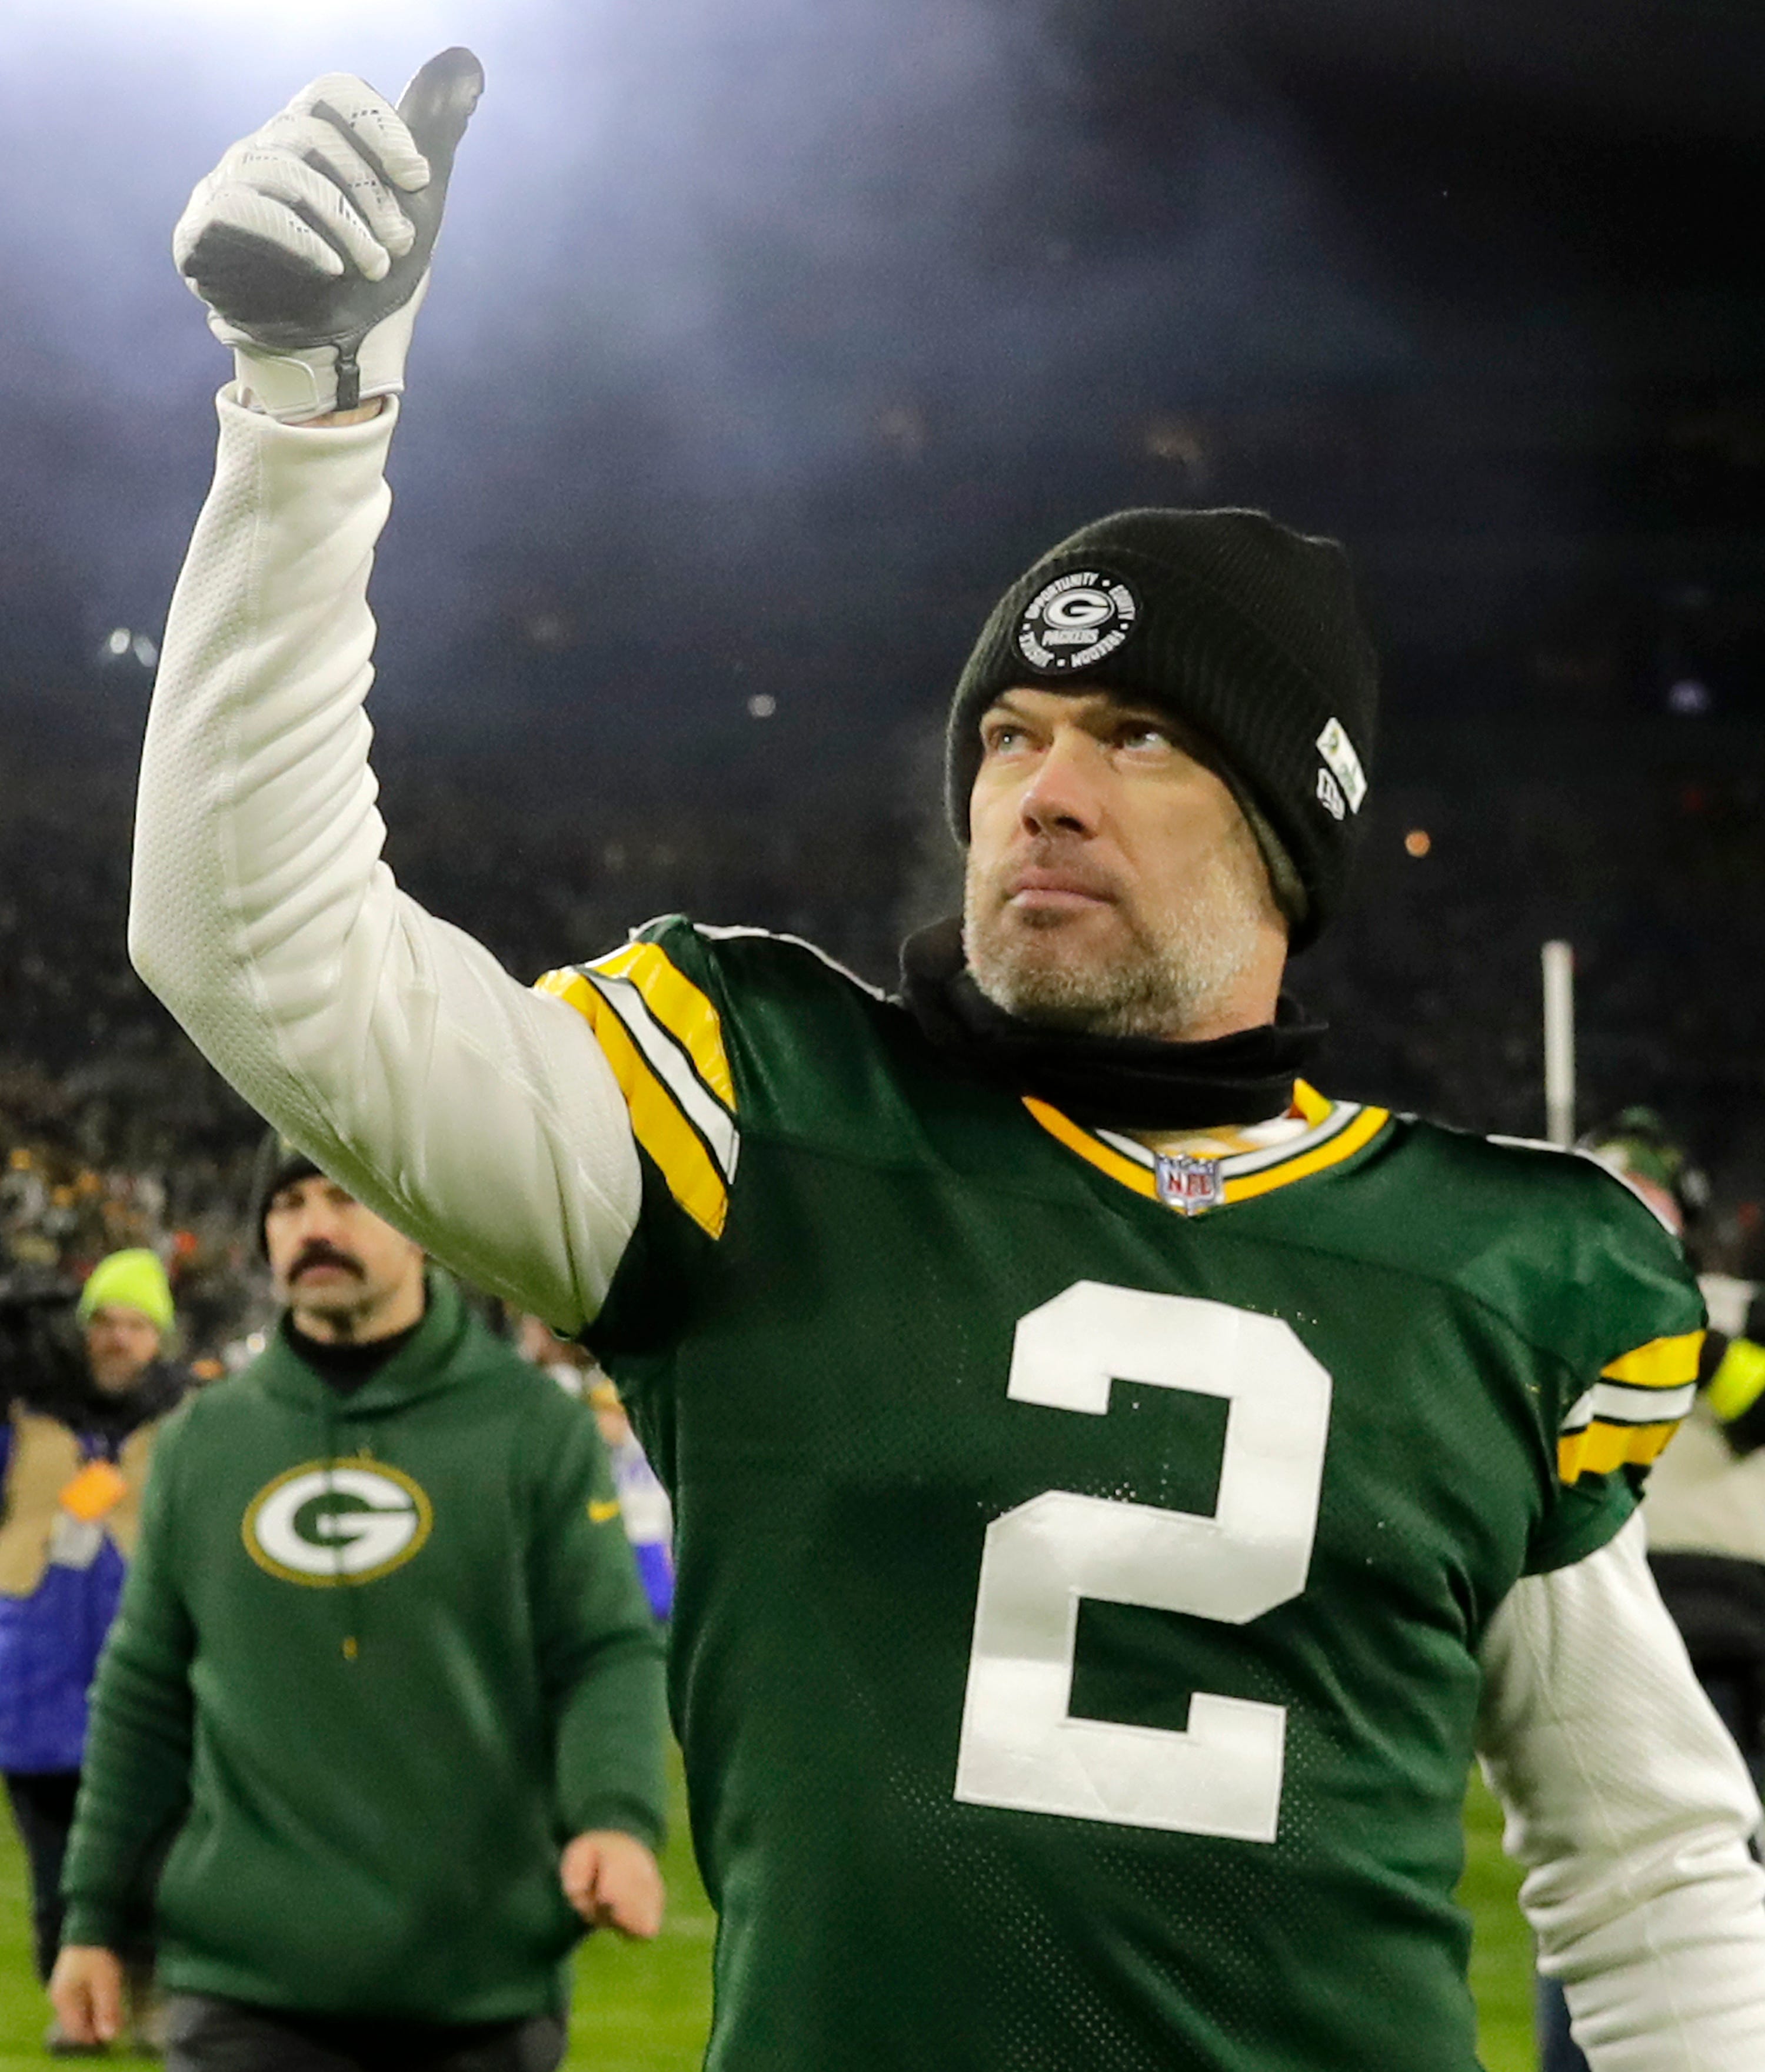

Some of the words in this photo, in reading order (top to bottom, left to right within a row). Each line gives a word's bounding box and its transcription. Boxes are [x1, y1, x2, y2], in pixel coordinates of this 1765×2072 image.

[1047, 590, 1112, 626] G
[1168, 1171, 1211, 1197] NFL
[254, 1466, 418, 1577] G
[954, 1279, 1333, 1843] 2
